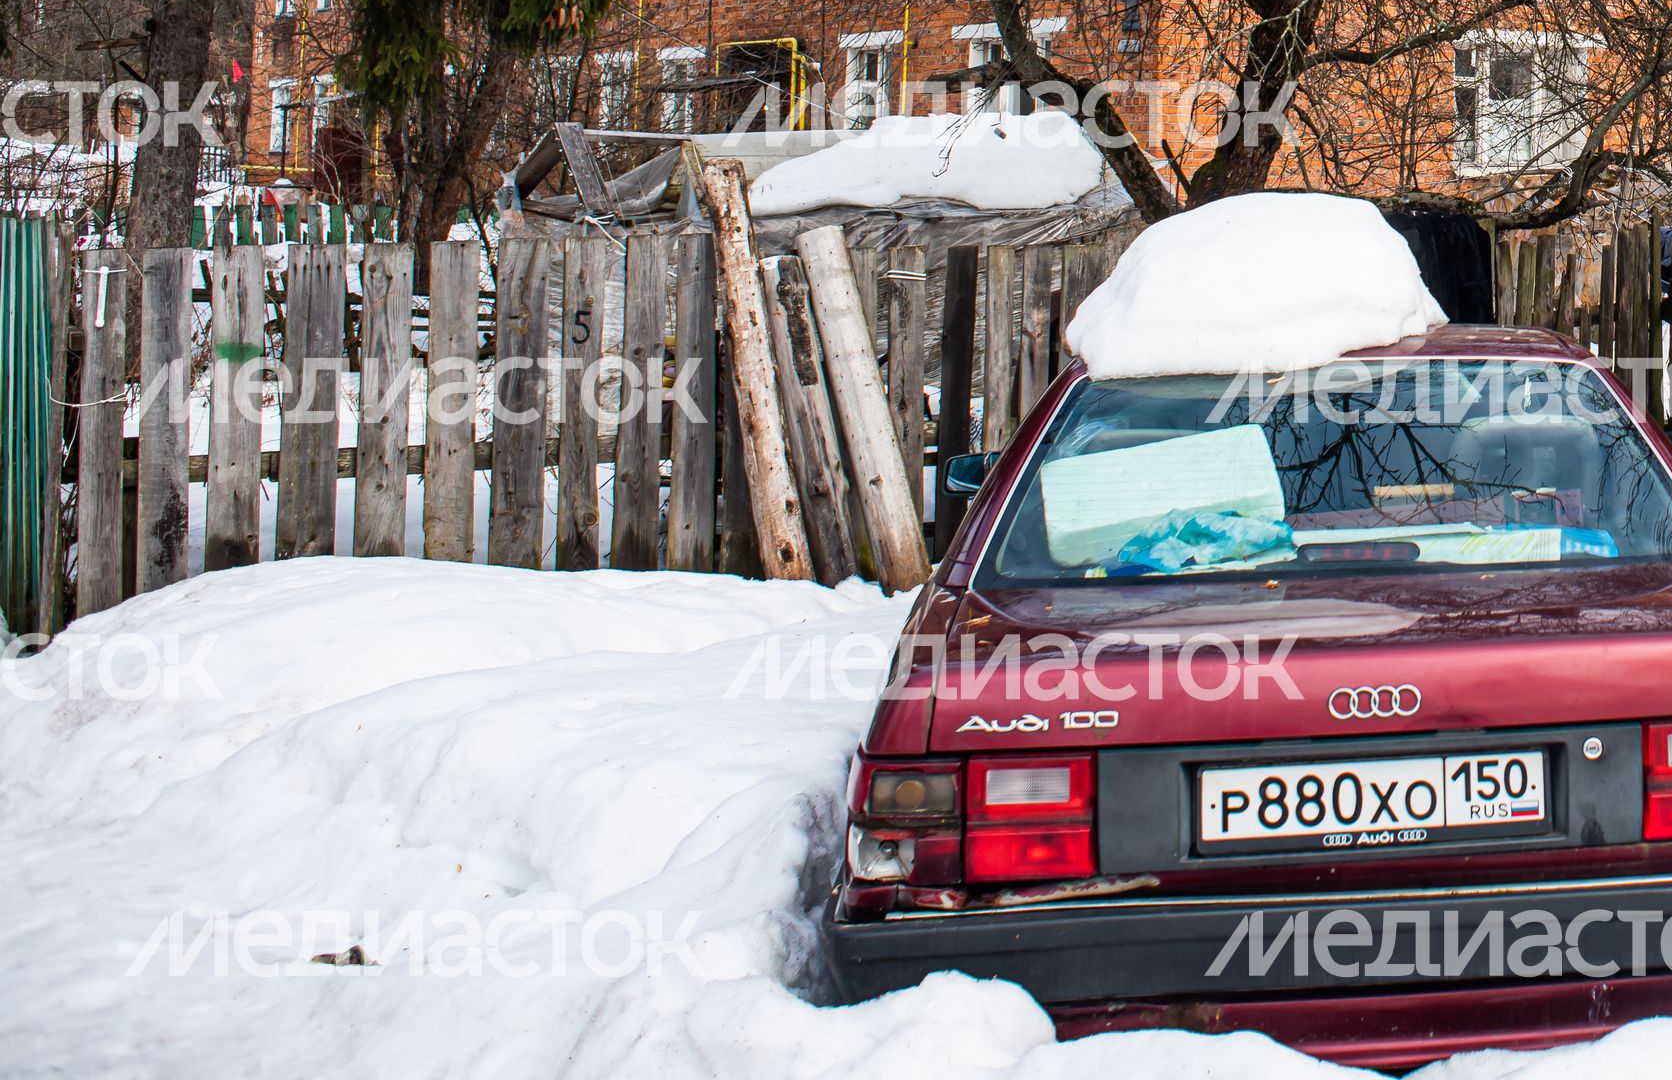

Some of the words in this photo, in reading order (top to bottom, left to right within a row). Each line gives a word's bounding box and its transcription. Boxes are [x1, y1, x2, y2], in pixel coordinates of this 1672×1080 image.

[572, 310, 591, 344] 5
[955, 714, 1050, 733] Audi
[1059, 710, 1119, 729] 100
[1450, 758, 1528, 802] 150
[1470, 803, 1509, 819] RUS
[1357, 830, 1395, 845] Audi
